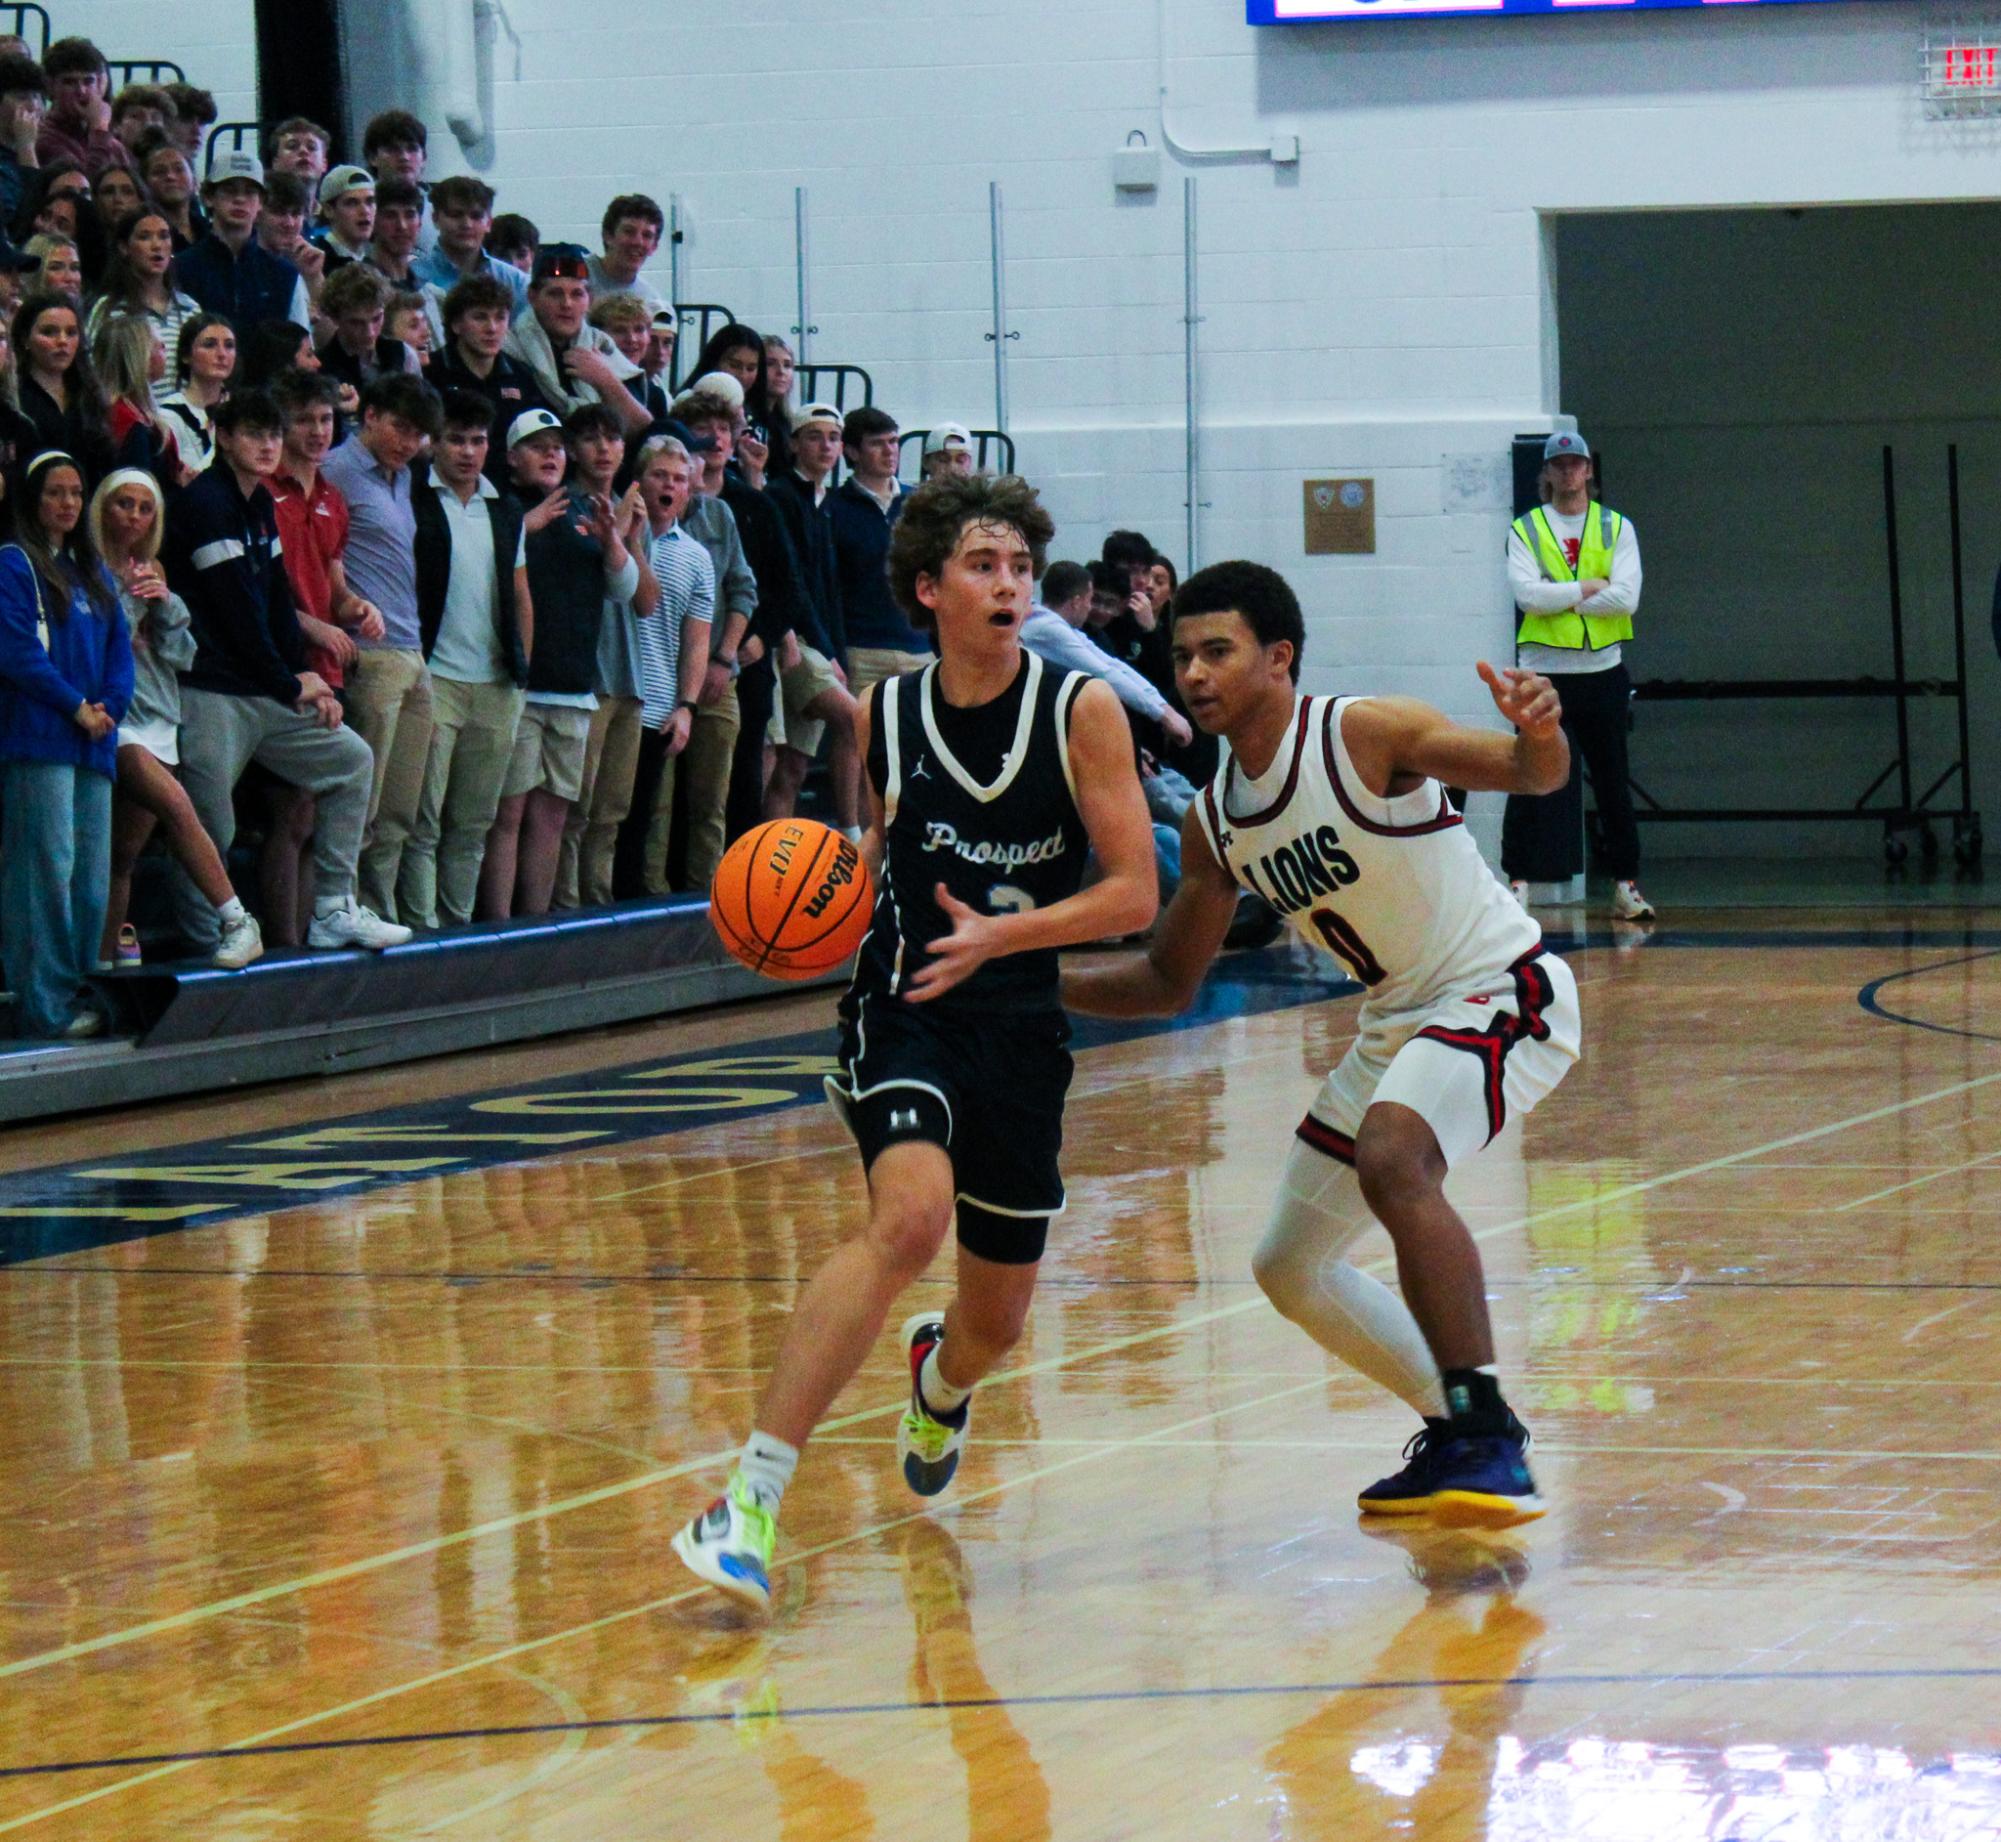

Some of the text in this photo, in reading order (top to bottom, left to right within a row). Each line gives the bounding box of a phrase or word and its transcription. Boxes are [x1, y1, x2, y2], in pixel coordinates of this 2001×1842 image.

[1944, 47, 1999, 86] EXIT
[920, 821, 1067, 874] Prospect
[1241, 824, 1361, 915] LIONS
[1310, 907, 1389, 987] 0
